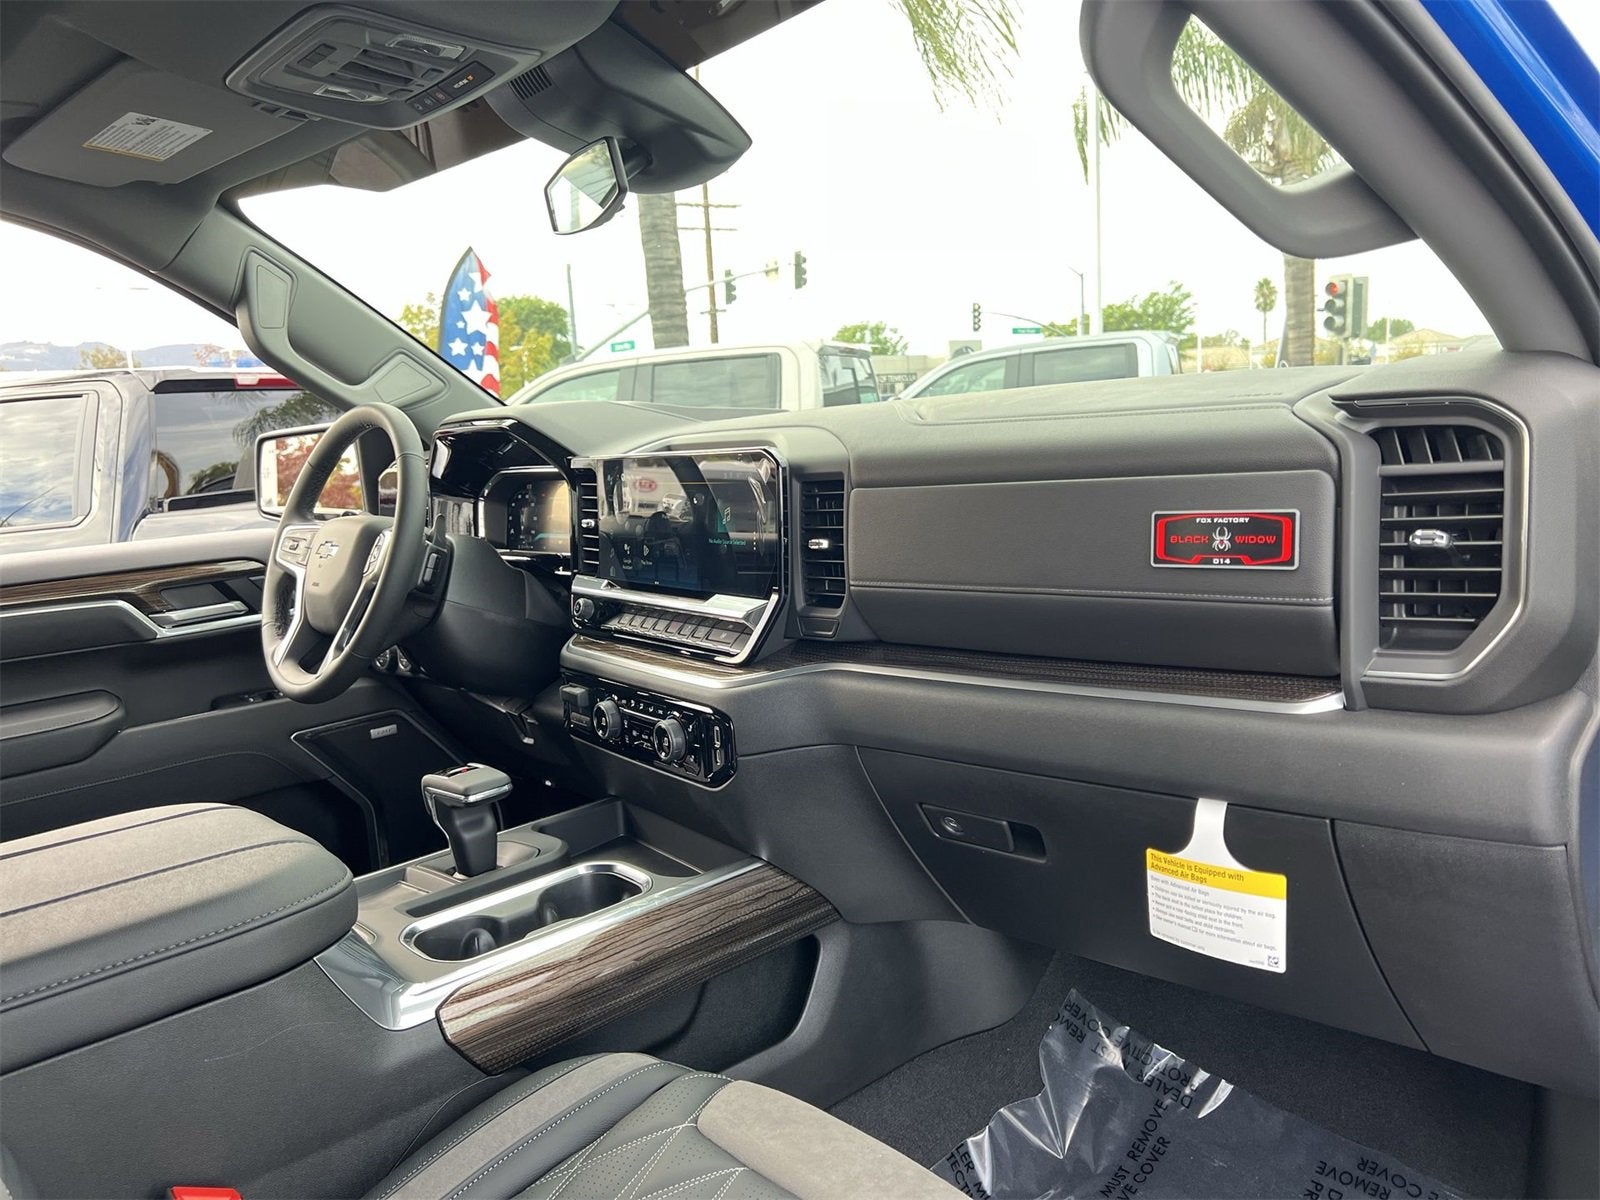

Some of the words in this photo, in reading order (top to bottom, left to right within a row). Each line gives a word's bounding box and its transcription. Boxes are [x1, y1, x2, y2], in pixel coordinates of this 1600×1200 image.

[1170, 535, 1209, 544] BLACK
[1234, 535, 1277, 544] WIDOW
[1150, 853, 1163, 863] This
[1163, 858, 1185, 870] Vehicle
[1187, 864, 1193, 872] is
[1194, 865, 1226, 879] Equipped
[1227, 873, 1245, 882] with
[1150, 862, 1179, 877] Advanced
[1180, 871, 1190, 879] Air
[1190, 873, 1208, 885] Bags
[1064, 1000, 1111, 1038] COVER
[1136, 1070, 1193, 1109] DEALER
[1100, 1165, 1130, 1198] MUST
[1126, 1099, 1168, 1161] REMOVE
[1133, 1136, 1171, 1183] COVER
[1315, 1160, 1392, 1200] REMOVE
[1356, 1157, 1422, 1198] COVER
